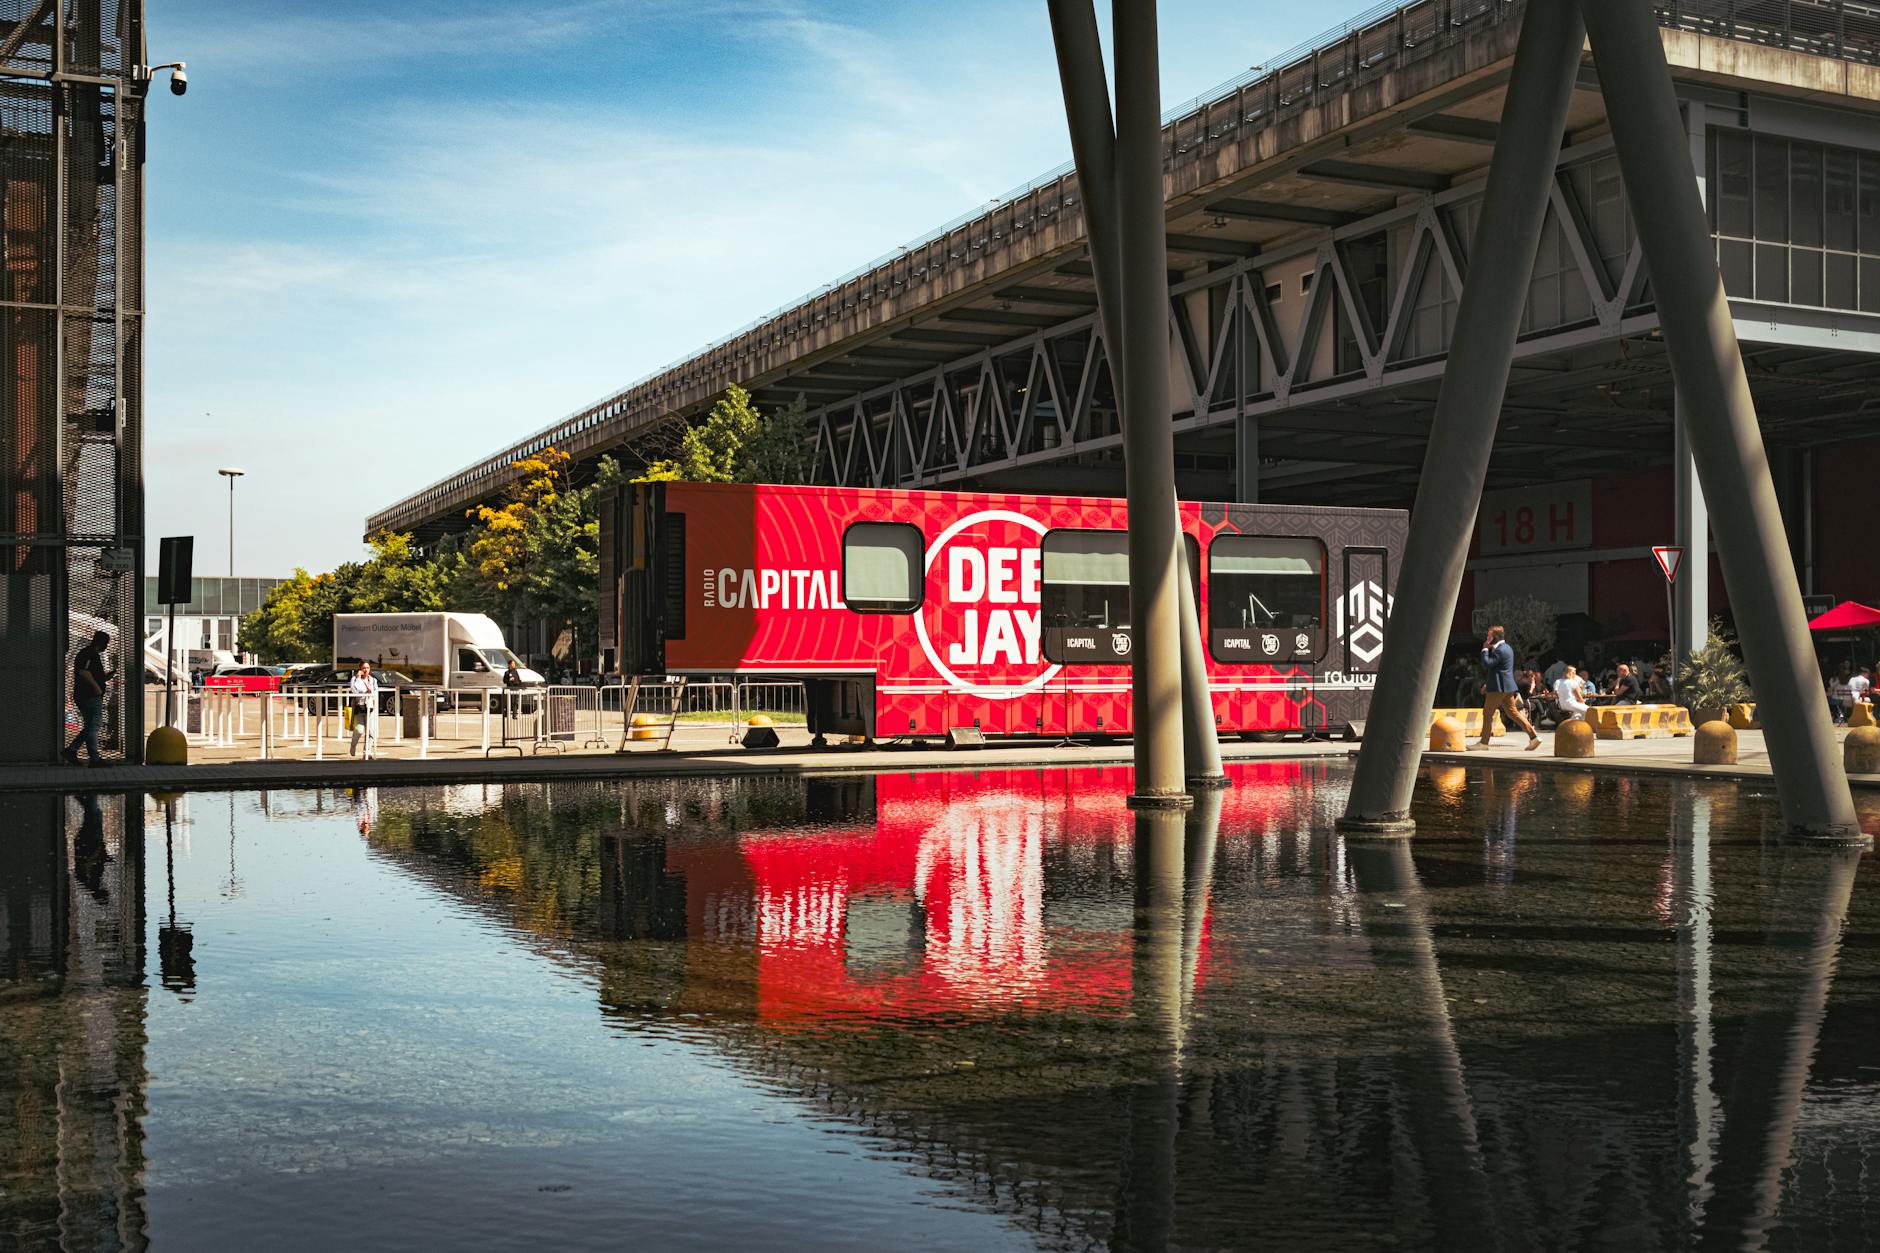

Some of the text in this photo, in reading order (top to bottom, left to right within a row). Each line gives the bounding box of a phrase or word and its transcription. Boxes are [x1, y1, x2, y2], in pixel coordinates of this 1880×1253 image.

[1493, 501, 1574, 546] 18 H
[703, 569, 715, 607] RADIO
[718, 567, 848, 609] CAPITAL
[949, 546, 1041, 603] DEE
[372, 623, 399, 632] Outdoor
[949, 609, 1041, 664] JAY
[1324, 667, 1377, 683] radio
